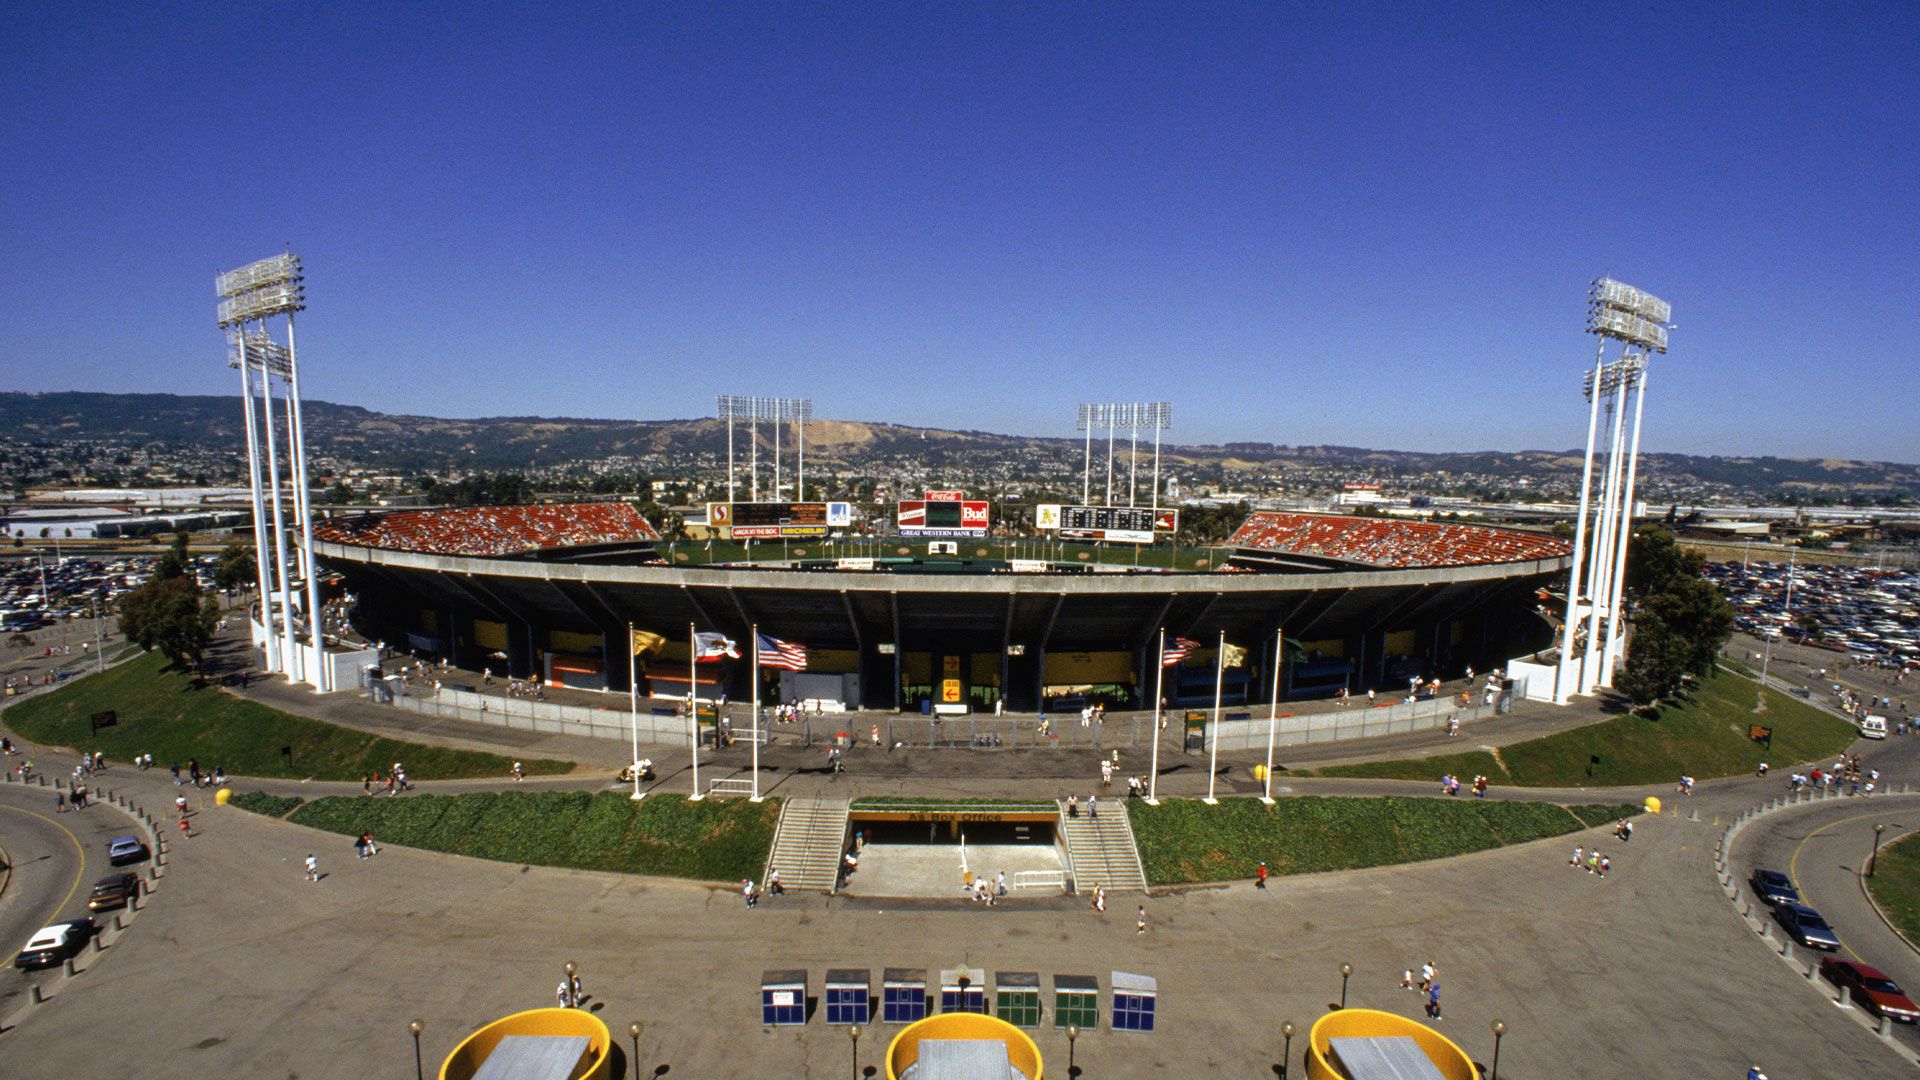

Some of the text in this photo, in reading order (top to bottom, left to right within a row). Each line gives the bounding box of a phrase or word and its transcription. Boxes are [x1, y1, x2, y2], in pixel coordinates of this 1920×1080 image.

[963, 507, 987, 519] Bud
[931, 813, 956, 821] Box
[961, 813, 1002, 821] Office
